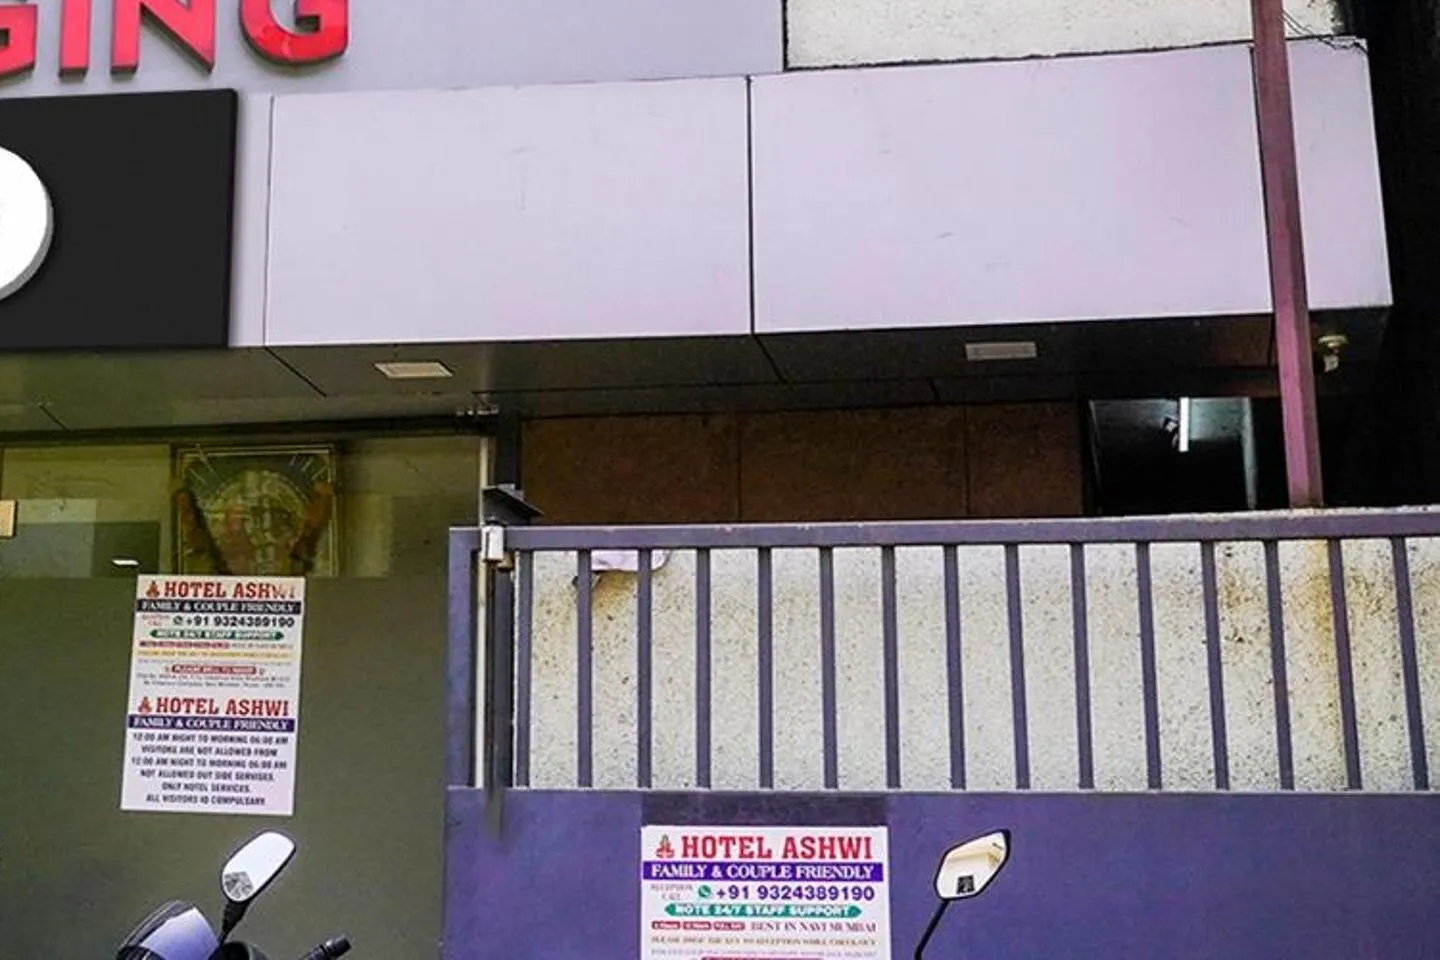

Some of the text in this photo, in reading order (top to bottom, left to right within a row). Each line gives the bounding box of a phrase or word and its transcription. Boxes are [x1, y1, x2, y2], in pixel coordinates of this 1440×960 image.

[164, 581, 226, 597] HOTEL
[142, 601, 294, 613] FAMILY & COUPLE FRIENDLY
[186, 616, 209, 627] +91
[156, 697, 288, 716] HOTEL ASHWI
[134, 718, 288, 730] FAMILY & COUPLE FRIENDLY
[157, 732, 169, 741] AM
[172, 733, 196, 742] NIGHT
[198, 734, 208, 743] TO
[211, 734, 248, 743] MORNING
[275, 736, 289, 744] AM
[141, 745, 278, 757] VISITORS ARE NOT ALLOWED FROM
[156, 757, 168, 765] AM
[170, 758, 194, 766] NIGHT
[196, 758, 206, 767] TO
[209, 759, 246, 768] MORNING
[274, 761, 287, 769] AM
[141, 769, 156, 778] NOT
[158, 770, 195, 779] ALLOWED
[162, 782, 181, 791] ONLY
[184, 783, 208, 792] HOTEL
[146, 794, 159, 802] ALL
[163, 794, 198, 804] VISITORS
[682, 836, 872, 859] HOTEL ASHWI
[651, 865, 874, 880] FAMILY & COUPLE FRIENDLY
[716, 885, 875, 900] +91 9324389190
[675, 904, 709, 916] NOTE
[745, 905, 785, 916] STAFF
[790, 906, 849, 917] SUPPORT
